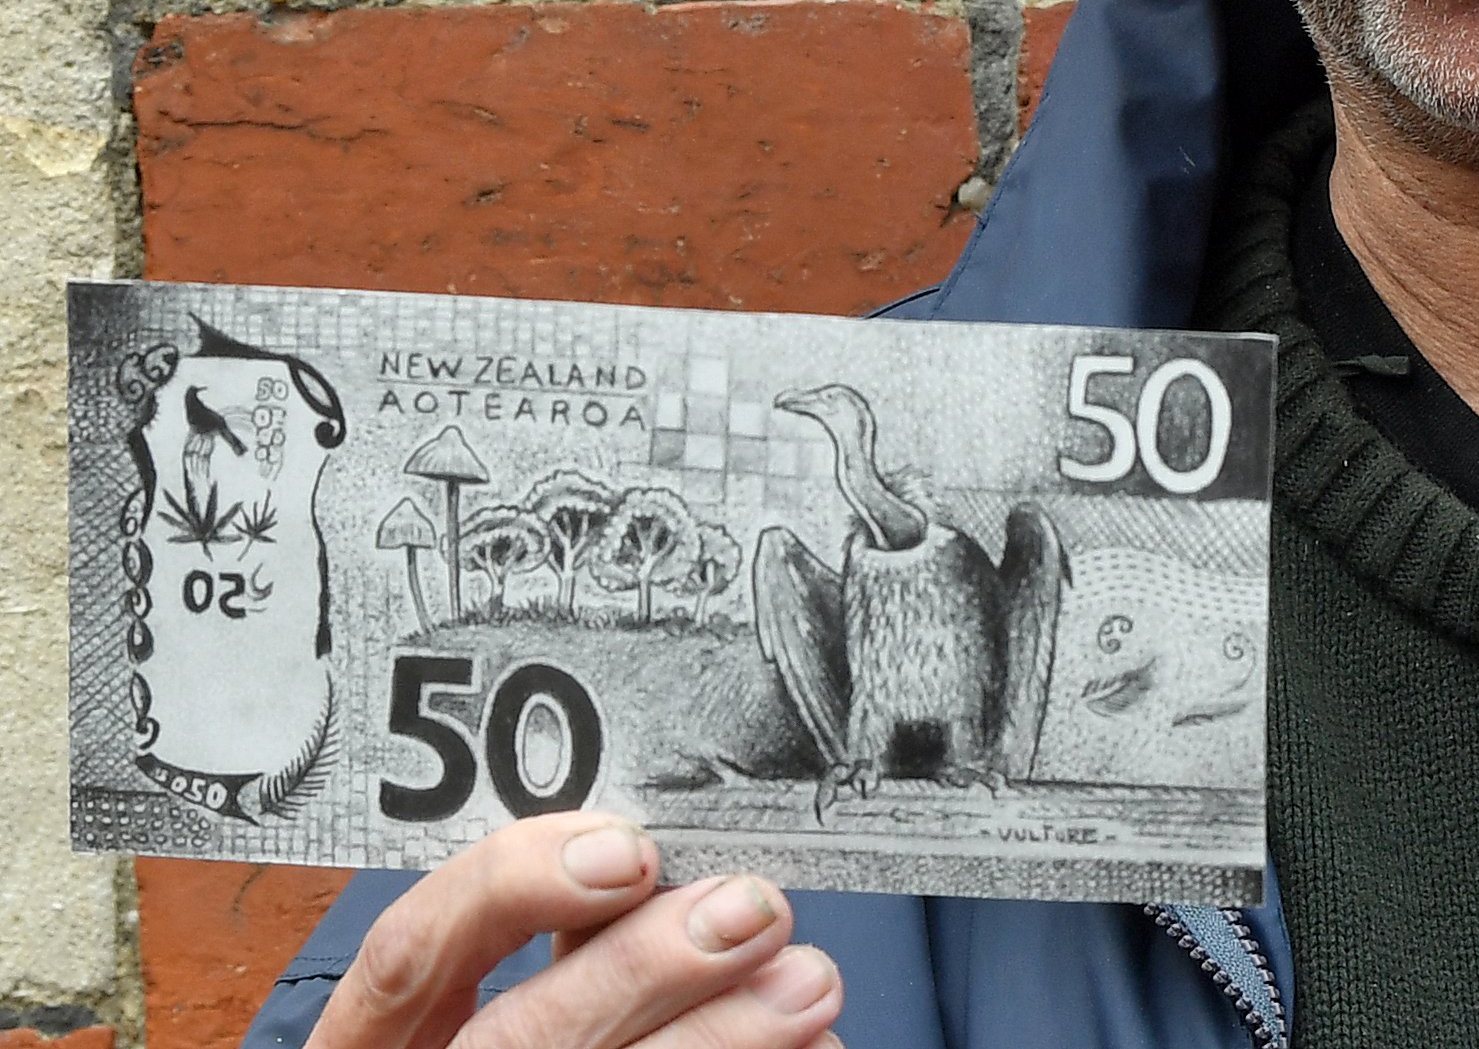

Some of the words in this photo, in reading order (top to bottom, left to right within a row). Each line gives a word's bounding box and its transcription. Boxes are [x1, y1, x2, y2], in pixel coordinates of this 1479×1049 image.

[379, 352, 462, 379] NEW
[473, 355, 647, 391] ZEALAND
[379, 389, 646, 432] AOTEAROA
[1058, 354, 1234, 495] 50
[380, 657, 604, 822] 50
[998, 824, 1098, 845] VULTURE
